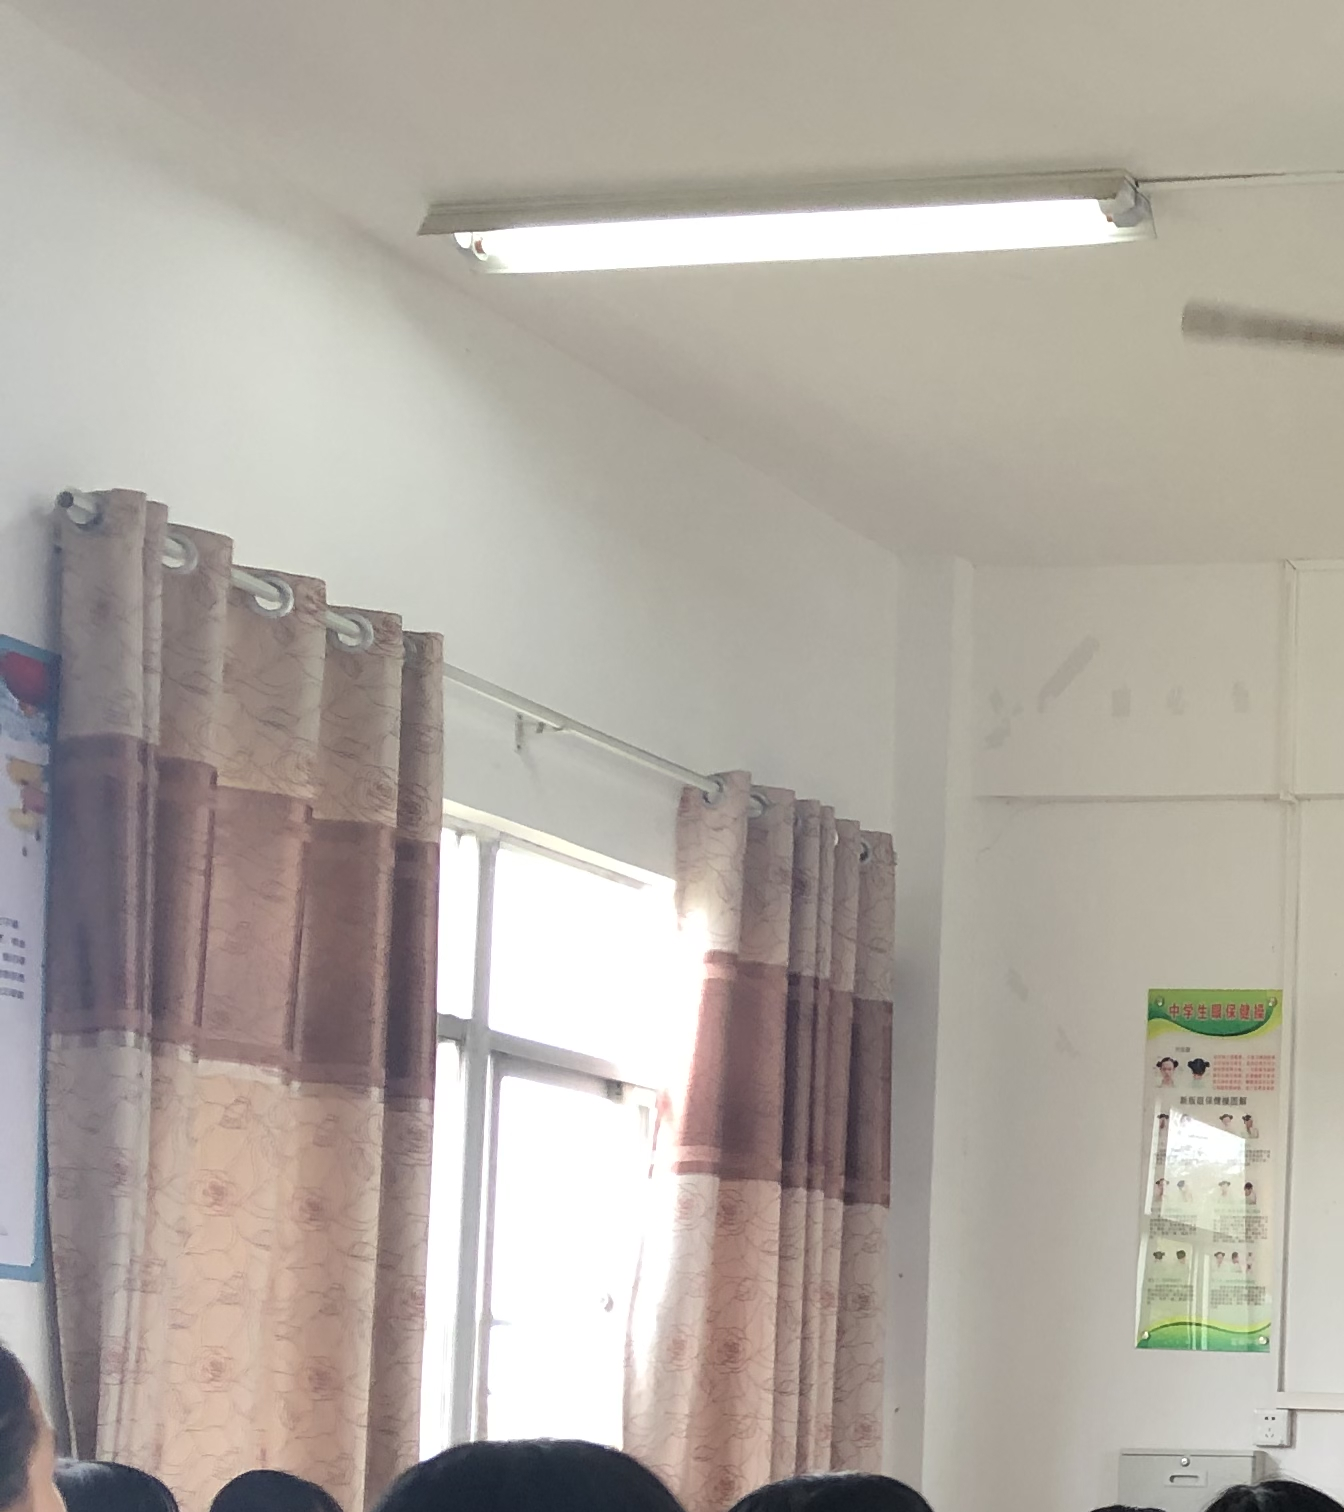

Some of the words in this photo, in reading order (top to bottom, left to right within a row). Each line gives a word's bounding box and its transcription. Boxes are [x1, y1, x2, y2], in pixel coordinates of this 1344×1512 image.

[1168, 1003, 1265, 1020] 中学生眼保健操
